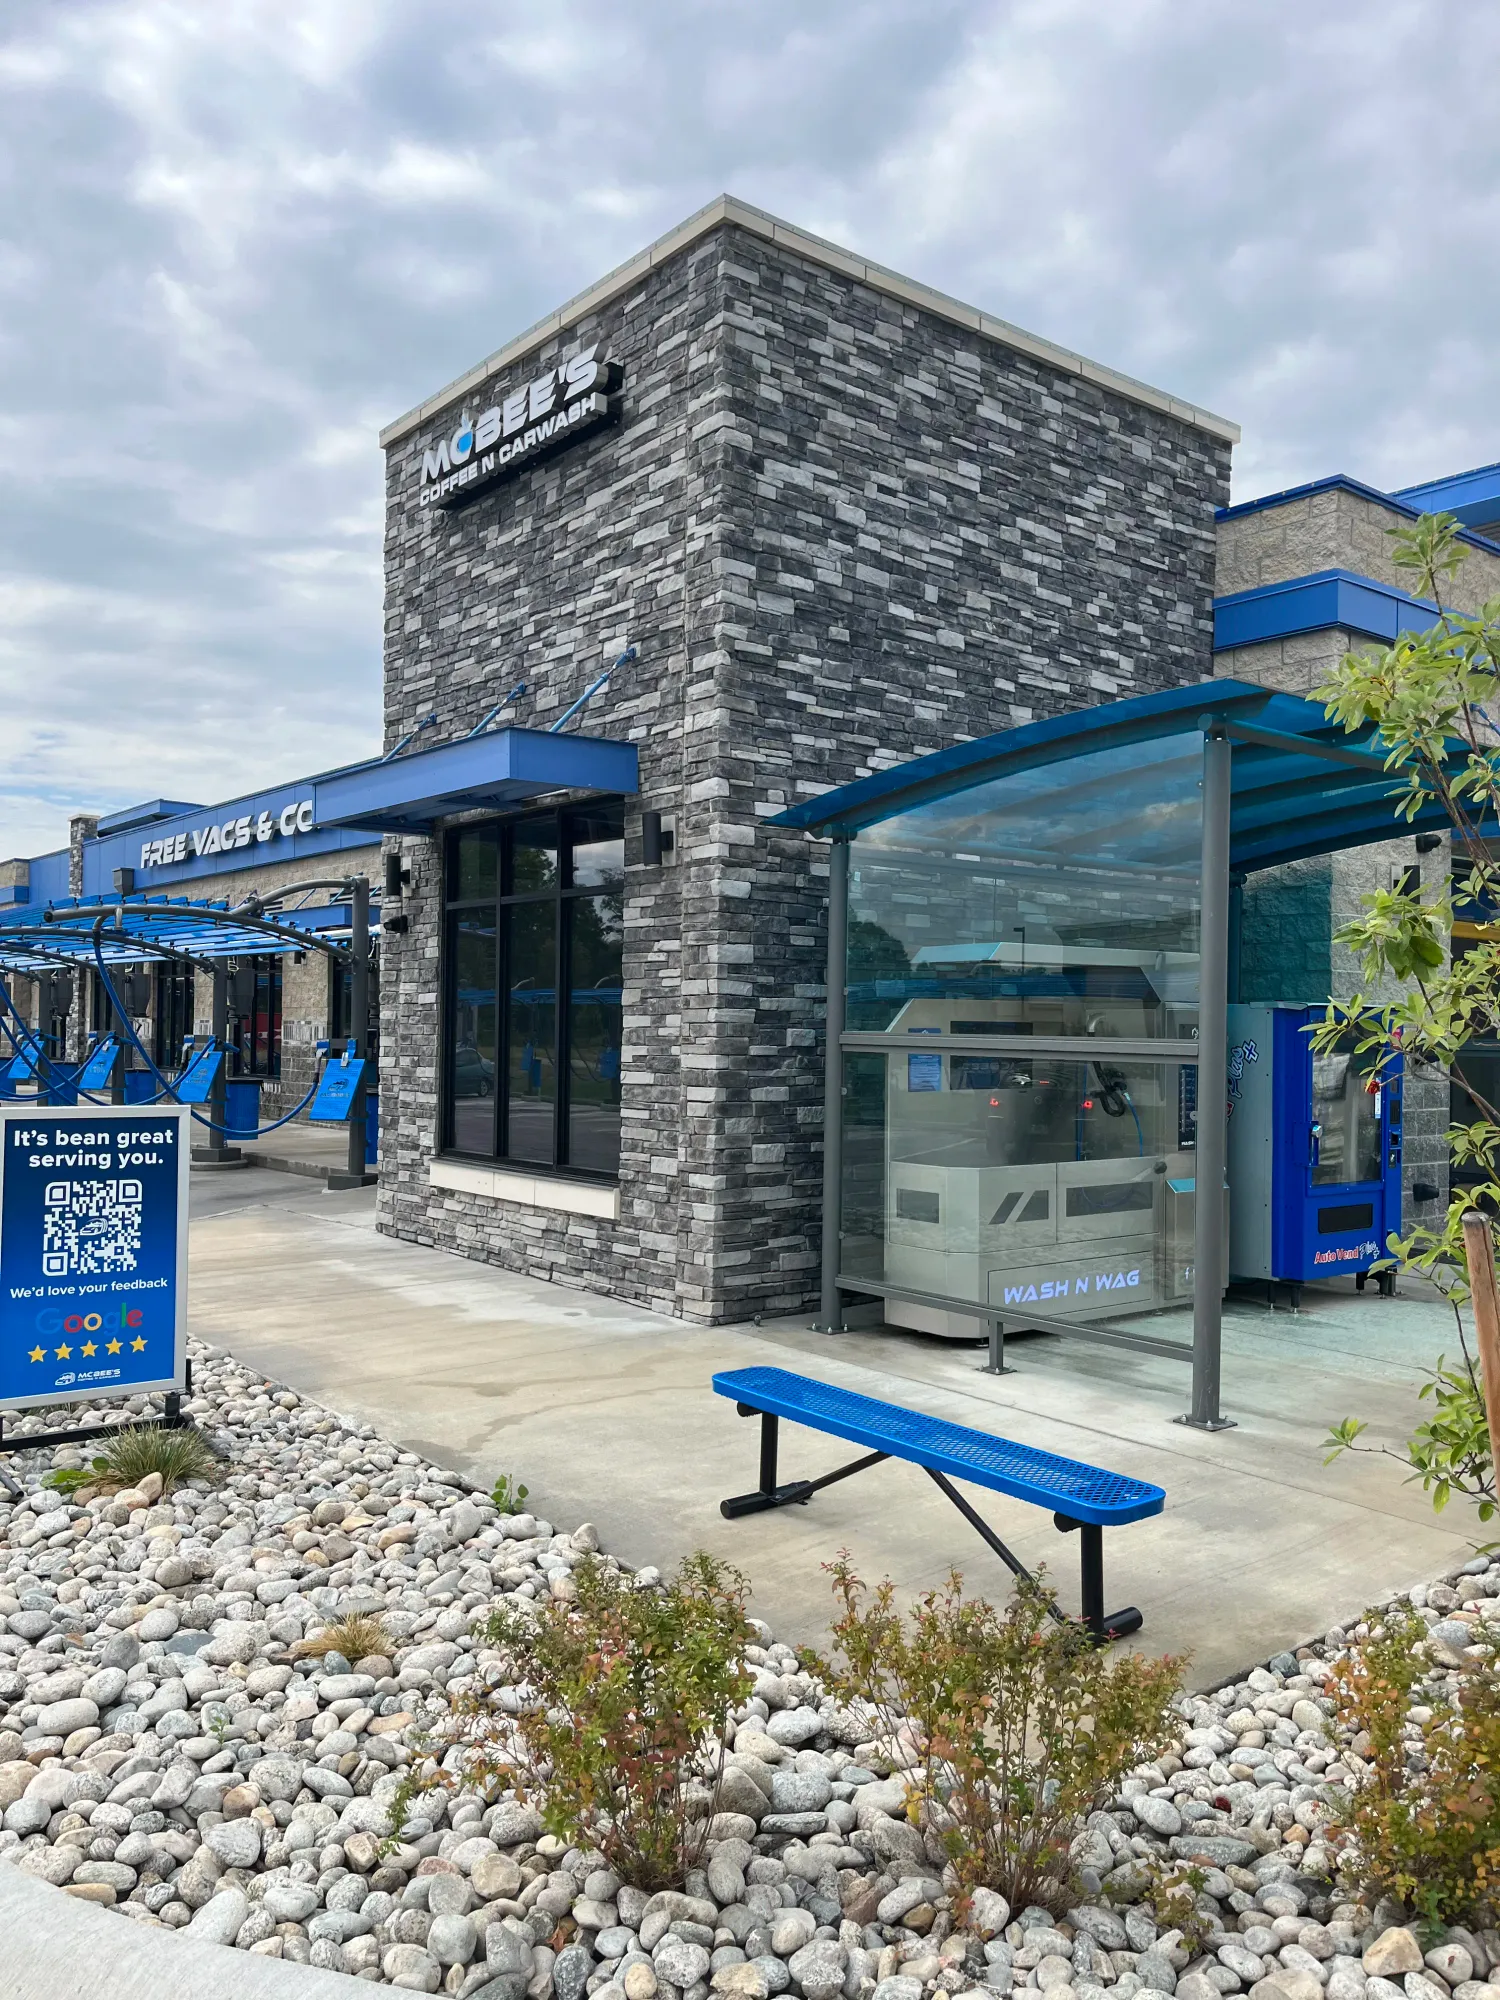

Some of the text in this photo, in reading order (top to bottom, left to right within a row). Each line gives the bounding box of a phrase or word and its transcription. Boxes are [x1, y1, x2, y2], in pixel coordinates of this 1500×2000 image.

[419, 392, 596, 506] COFFEE N CARWASH
[141, 832, 187, 869] FREE
[192, 816, 252, 856] VACS
[256, 810, 273, 842] &
[14, 1129, 173, 1148] It's bean great
[29, 1149, 164, 1169] serving you.
[1314, 1250, 1337, 1264] Auto
[1336, 1246, 1359, 1260] Vend
[10, 1278, 168, 1299] We'd love your feedback
[1004, 1269, 1140, 1305] WASH N WAG
[35, 1302, 144, 1336] Google
